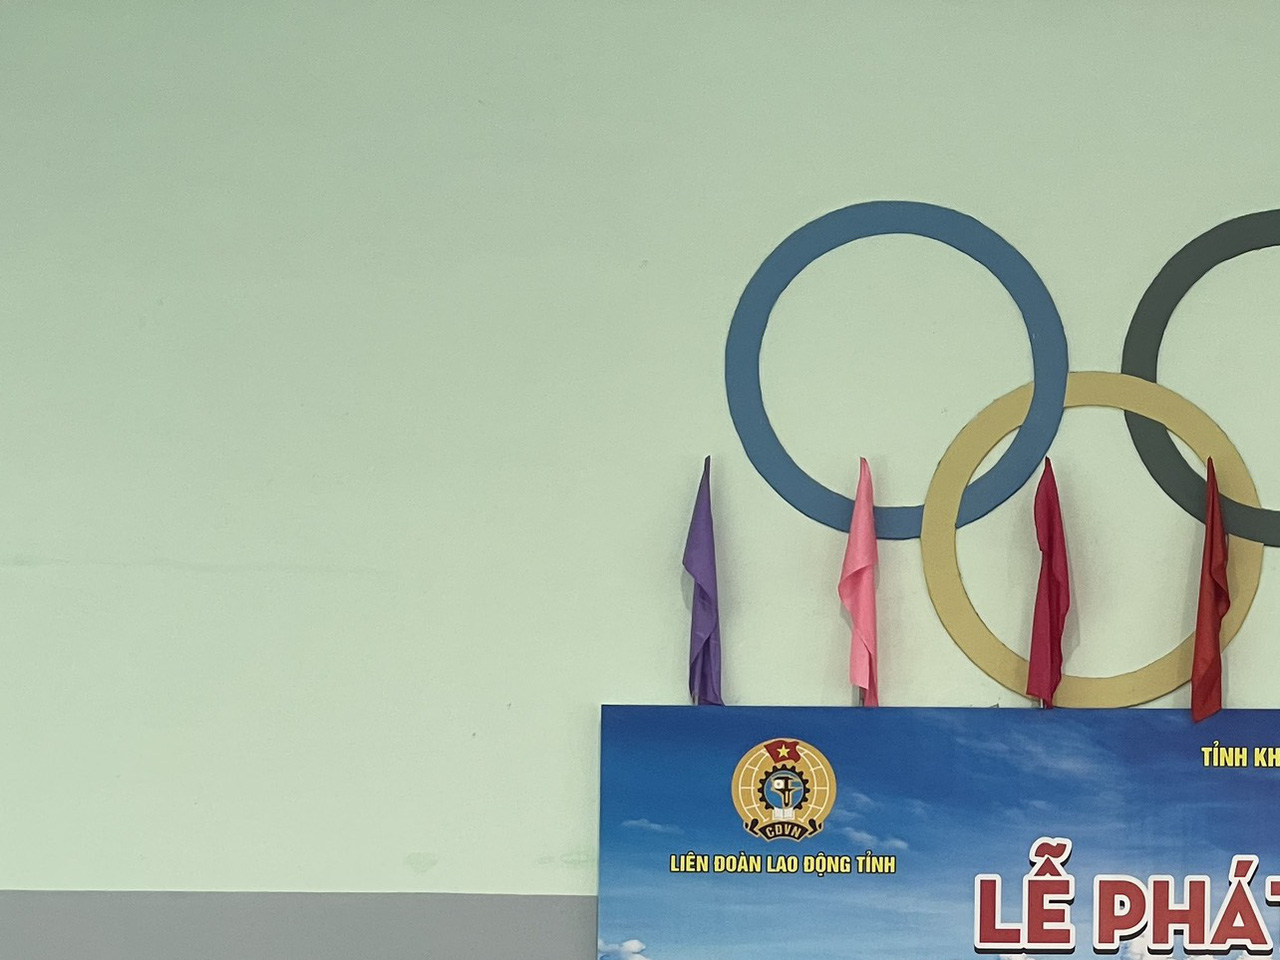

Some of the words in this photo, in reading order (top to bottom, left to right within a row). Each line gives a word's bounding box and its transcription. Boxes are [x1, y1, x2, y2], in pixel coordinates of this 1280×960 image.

[1201, 740, 1247, 767] TỈNH
[670, 851, 708, 872] LIÊN
[713, 851, 761, 873] ĐOÀN
[766, 855, 798, 873] LAO
[803, 852, 850, 877] ĐỘNG
[856, 850, 896, 873] TỈNH
[976, 838, 1074, 950] LỄ
